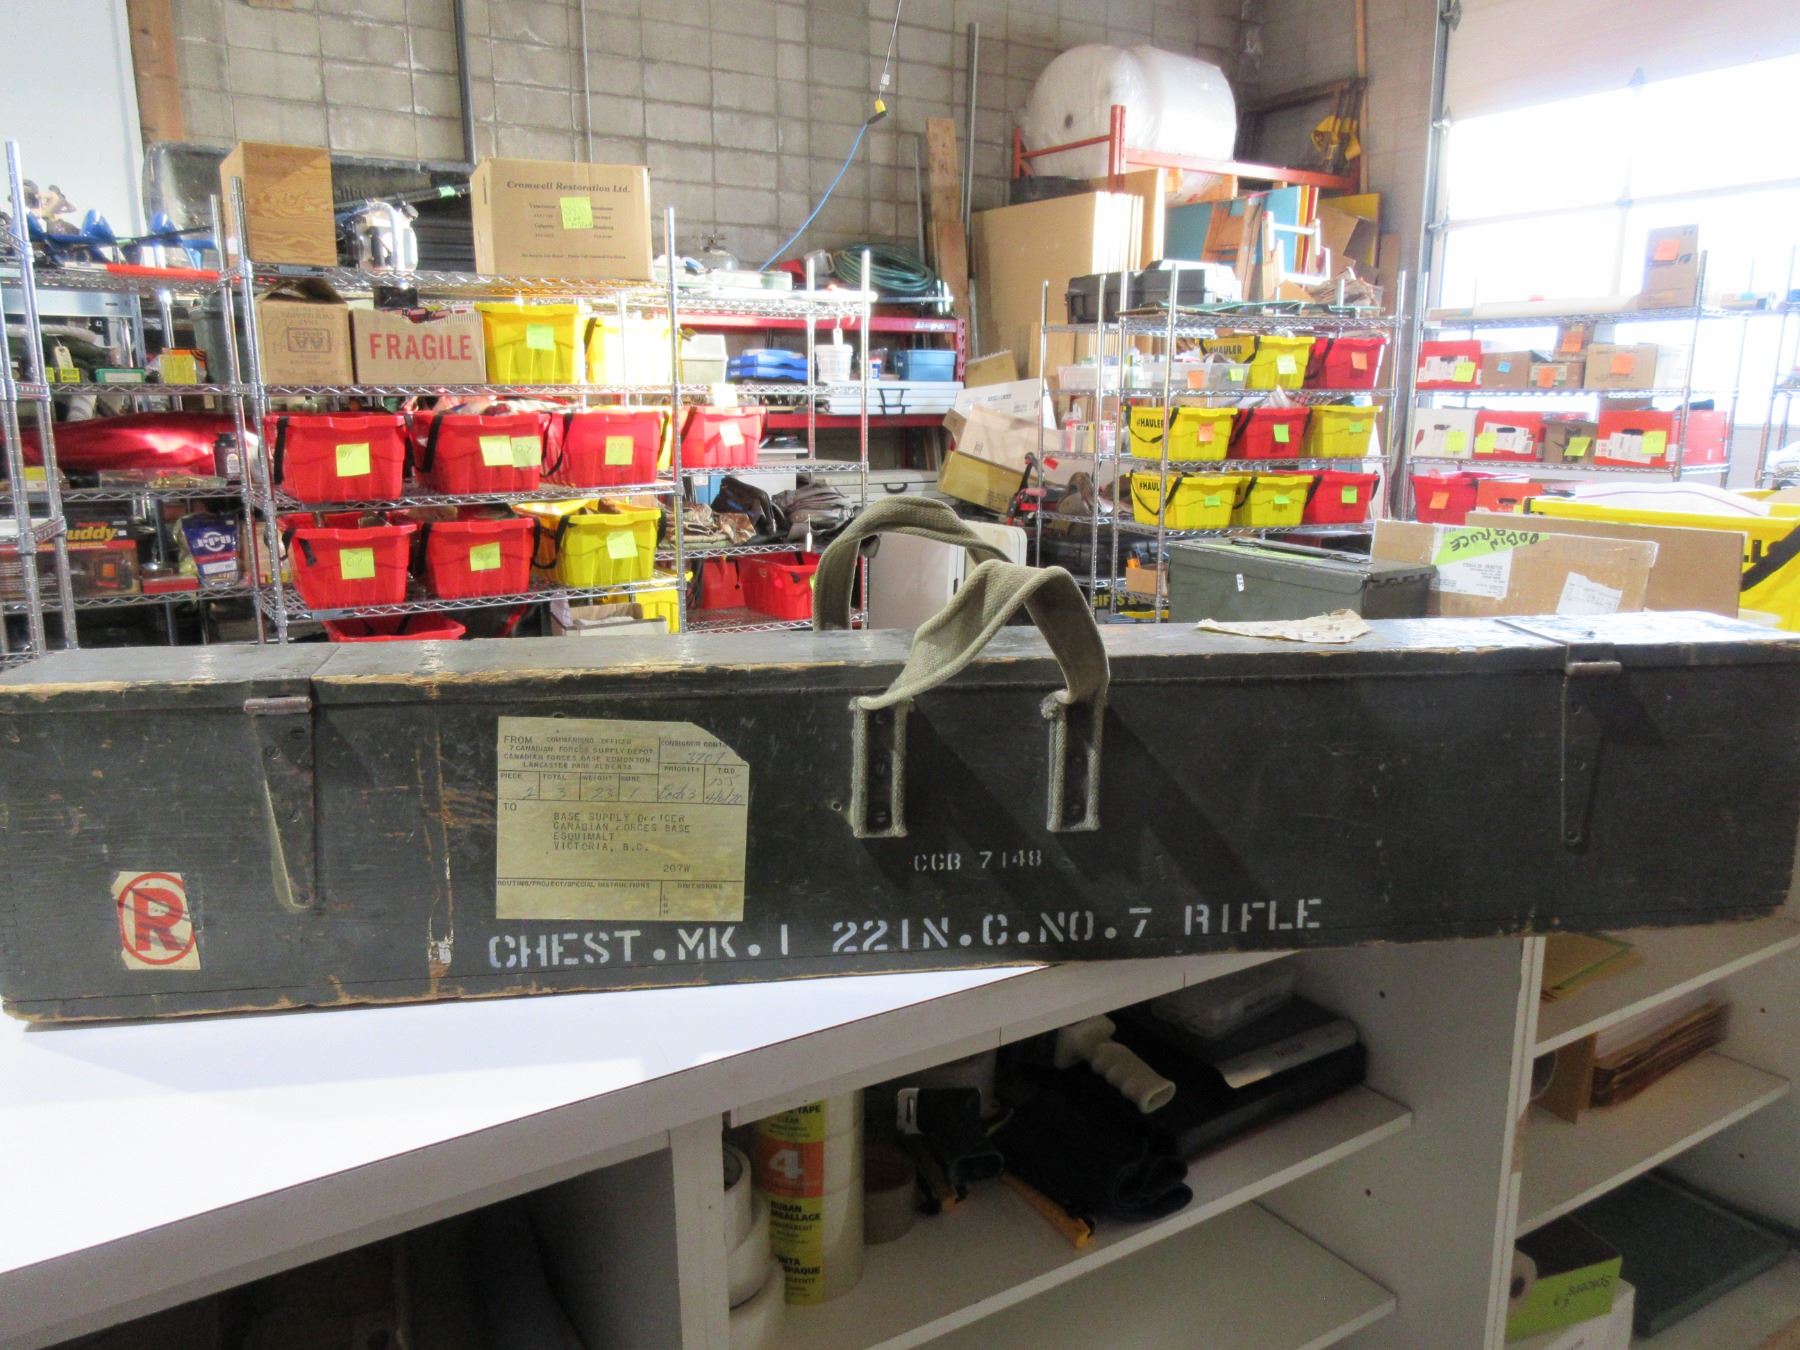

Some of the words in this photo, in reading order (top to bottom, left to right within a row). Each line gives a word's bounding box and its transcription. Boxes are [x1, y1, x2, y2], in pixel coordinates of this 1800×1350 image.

[555, 181, 610, 193] Restoration
[613, 185, 631, 194] Ltd.
[369, 332, 472, 361] FRAGILE
[66, 526, 118, 542] uddy
[503, 735, 533, 744] FROM
[515, 745, 554, 753] CANADIAN
[503, 752, 544, 761] CANADIAN
[546, 753, 577, 761] FORCES
[605, 755, 651, 763] EDMONTON
[523, 761, 568, 769] LANCASTER
[503, 802, 517, 811] TO
[553, 812, 580, 821] BASE
[589, 813, 630, 823] SUPPLY
[552, 822, 609, 832] CANADIAN
[616, 823, 657, 832] FORCES
[664, 824, 691, 833] BASE
[552, 831, 615, 841] ESQUIMALT
[663, 863, 691, 873] 207W
[1184, 898, 1322, 936] RIFLE
[768, 1148, 804, 1179] 4
